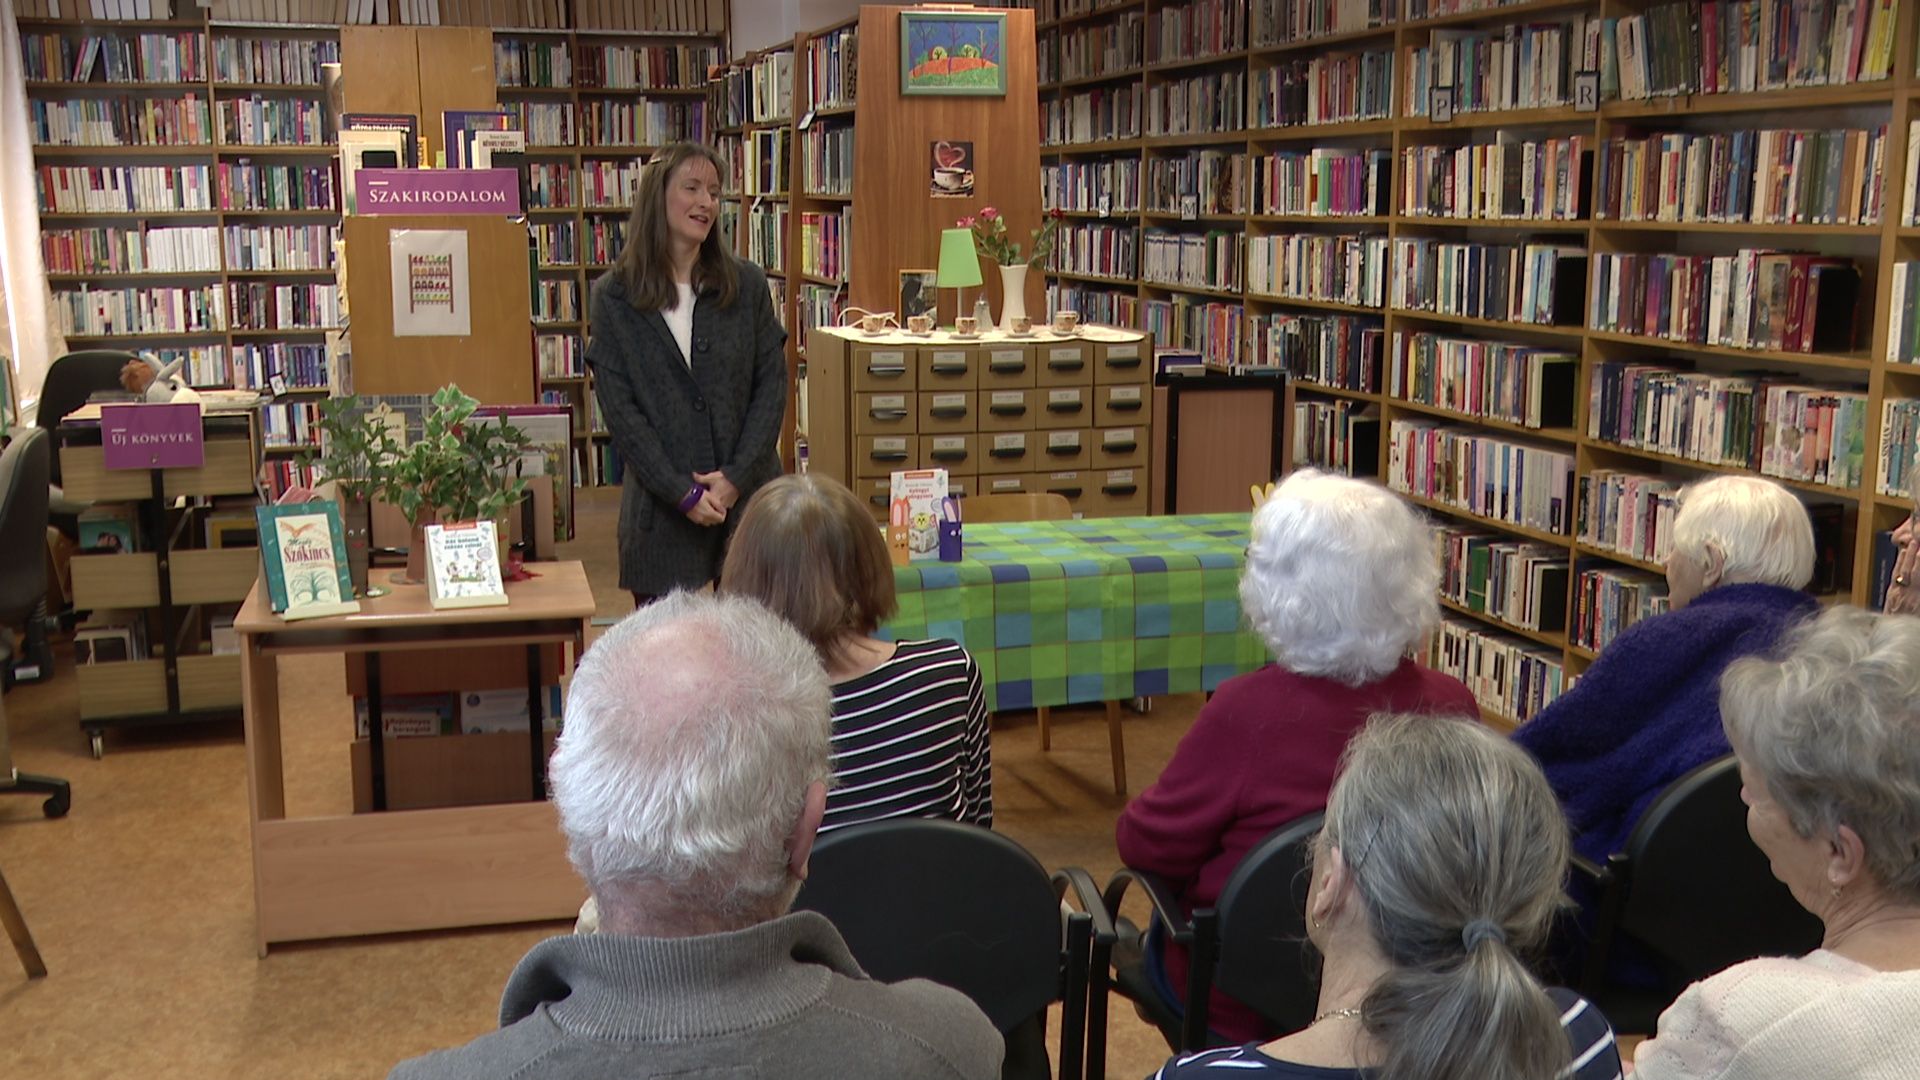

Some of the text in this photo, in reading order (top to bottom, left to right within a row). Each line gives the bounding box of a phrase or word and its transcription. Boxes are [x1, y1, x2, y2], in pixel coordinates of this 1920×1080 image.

[1580, 85, 1592, 104] R
[1437, 98, 1447, 116] P
[369, 189, 506, 203] SZAKIRODALOM
[1100, 200, 1107, 212] K
[1183, 202, 1195, 215] M
[131, 432, 193, 444] KÖNYVEK
[283, 544, 331, 563] Szókincs
